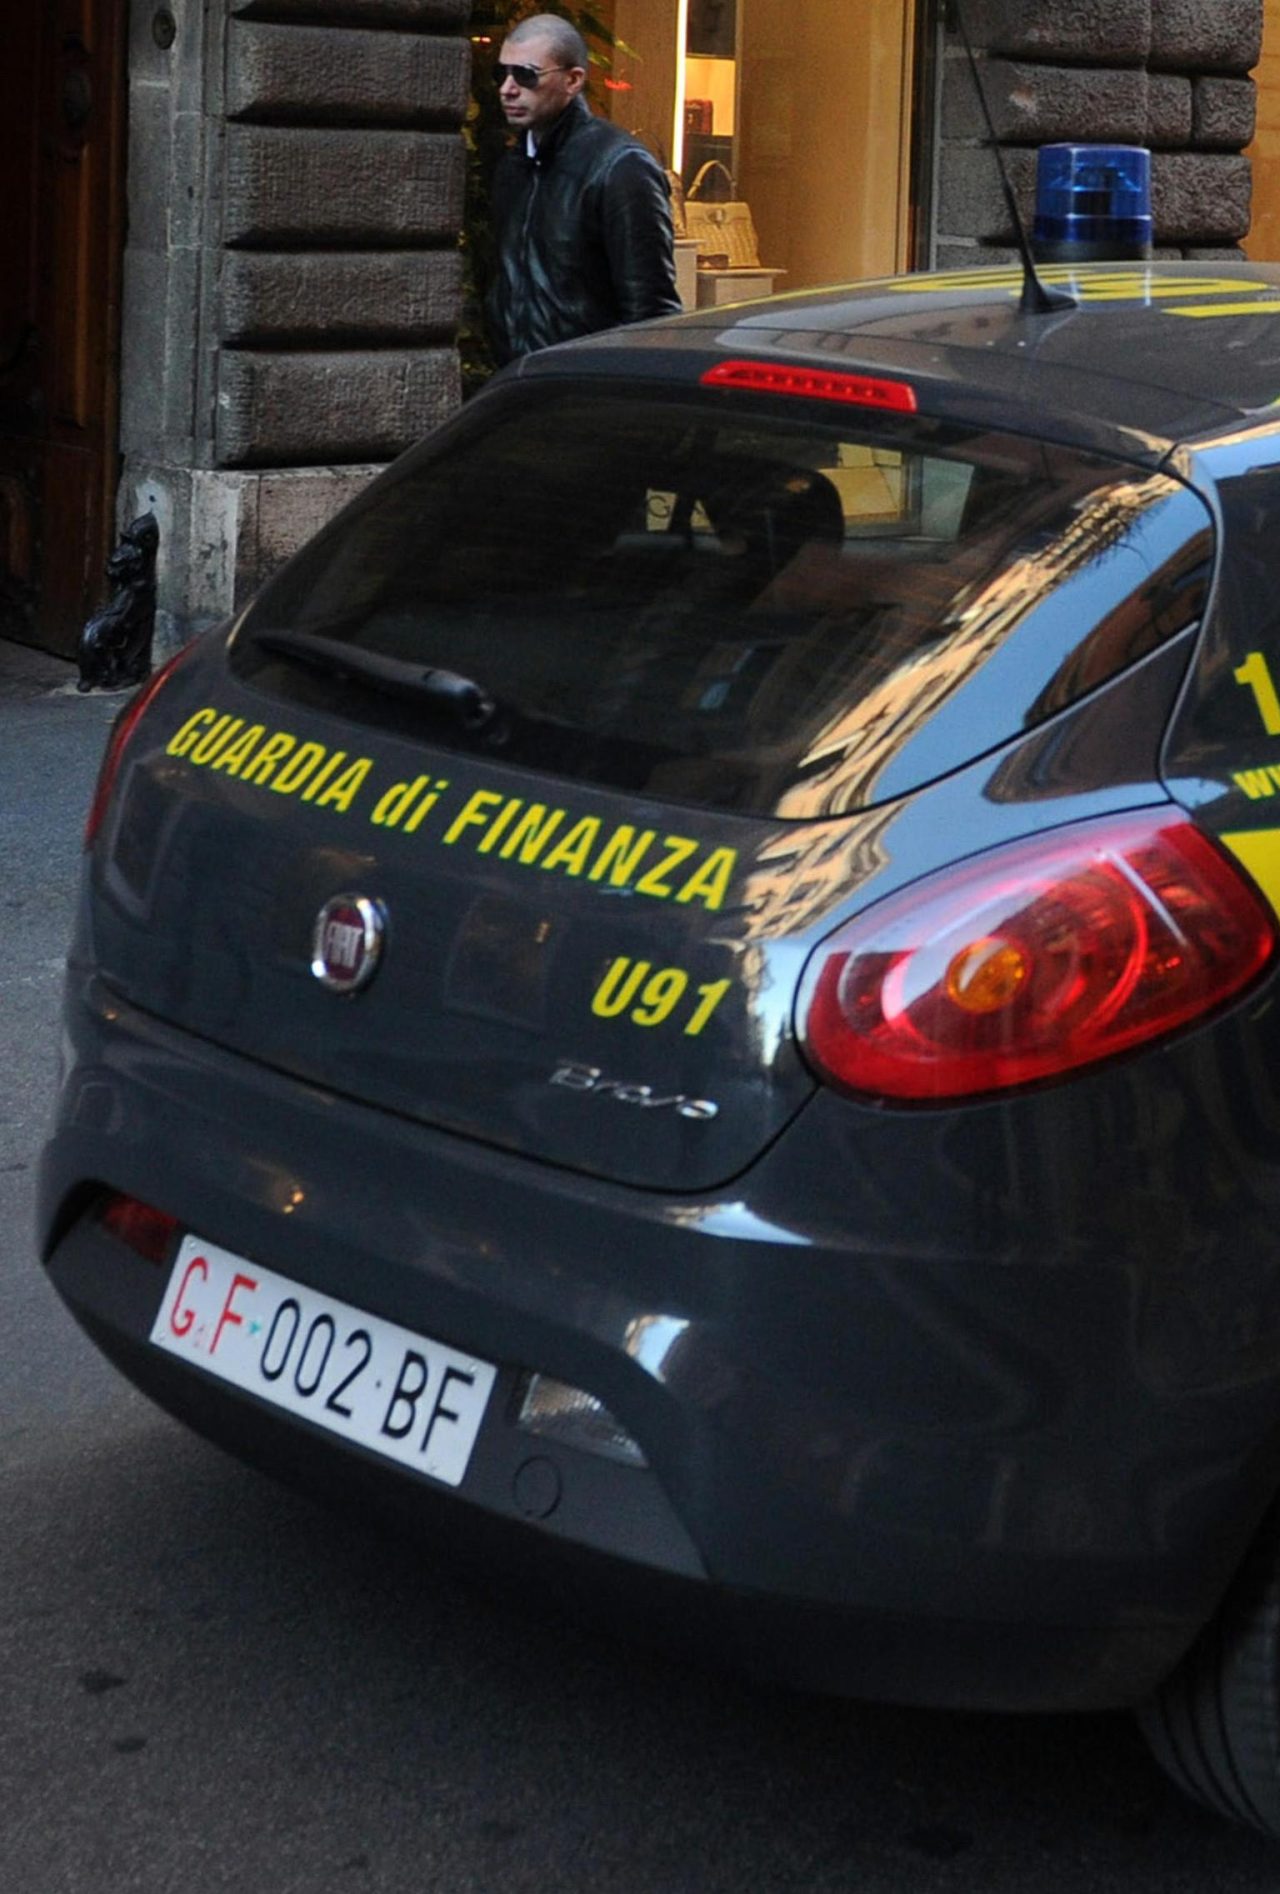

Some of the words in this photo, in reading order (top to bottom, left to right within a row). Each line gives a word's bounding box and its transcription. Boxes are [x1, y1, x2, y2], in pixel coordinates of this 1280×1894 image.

[165, 706, 375, 813] GUARDIA
[370, 773, 448, 834] di
[441, 788, 739, 912] FINANZA
[325, 921, 364, 969] FIAT
[590, 955, 733, 1037] U91
